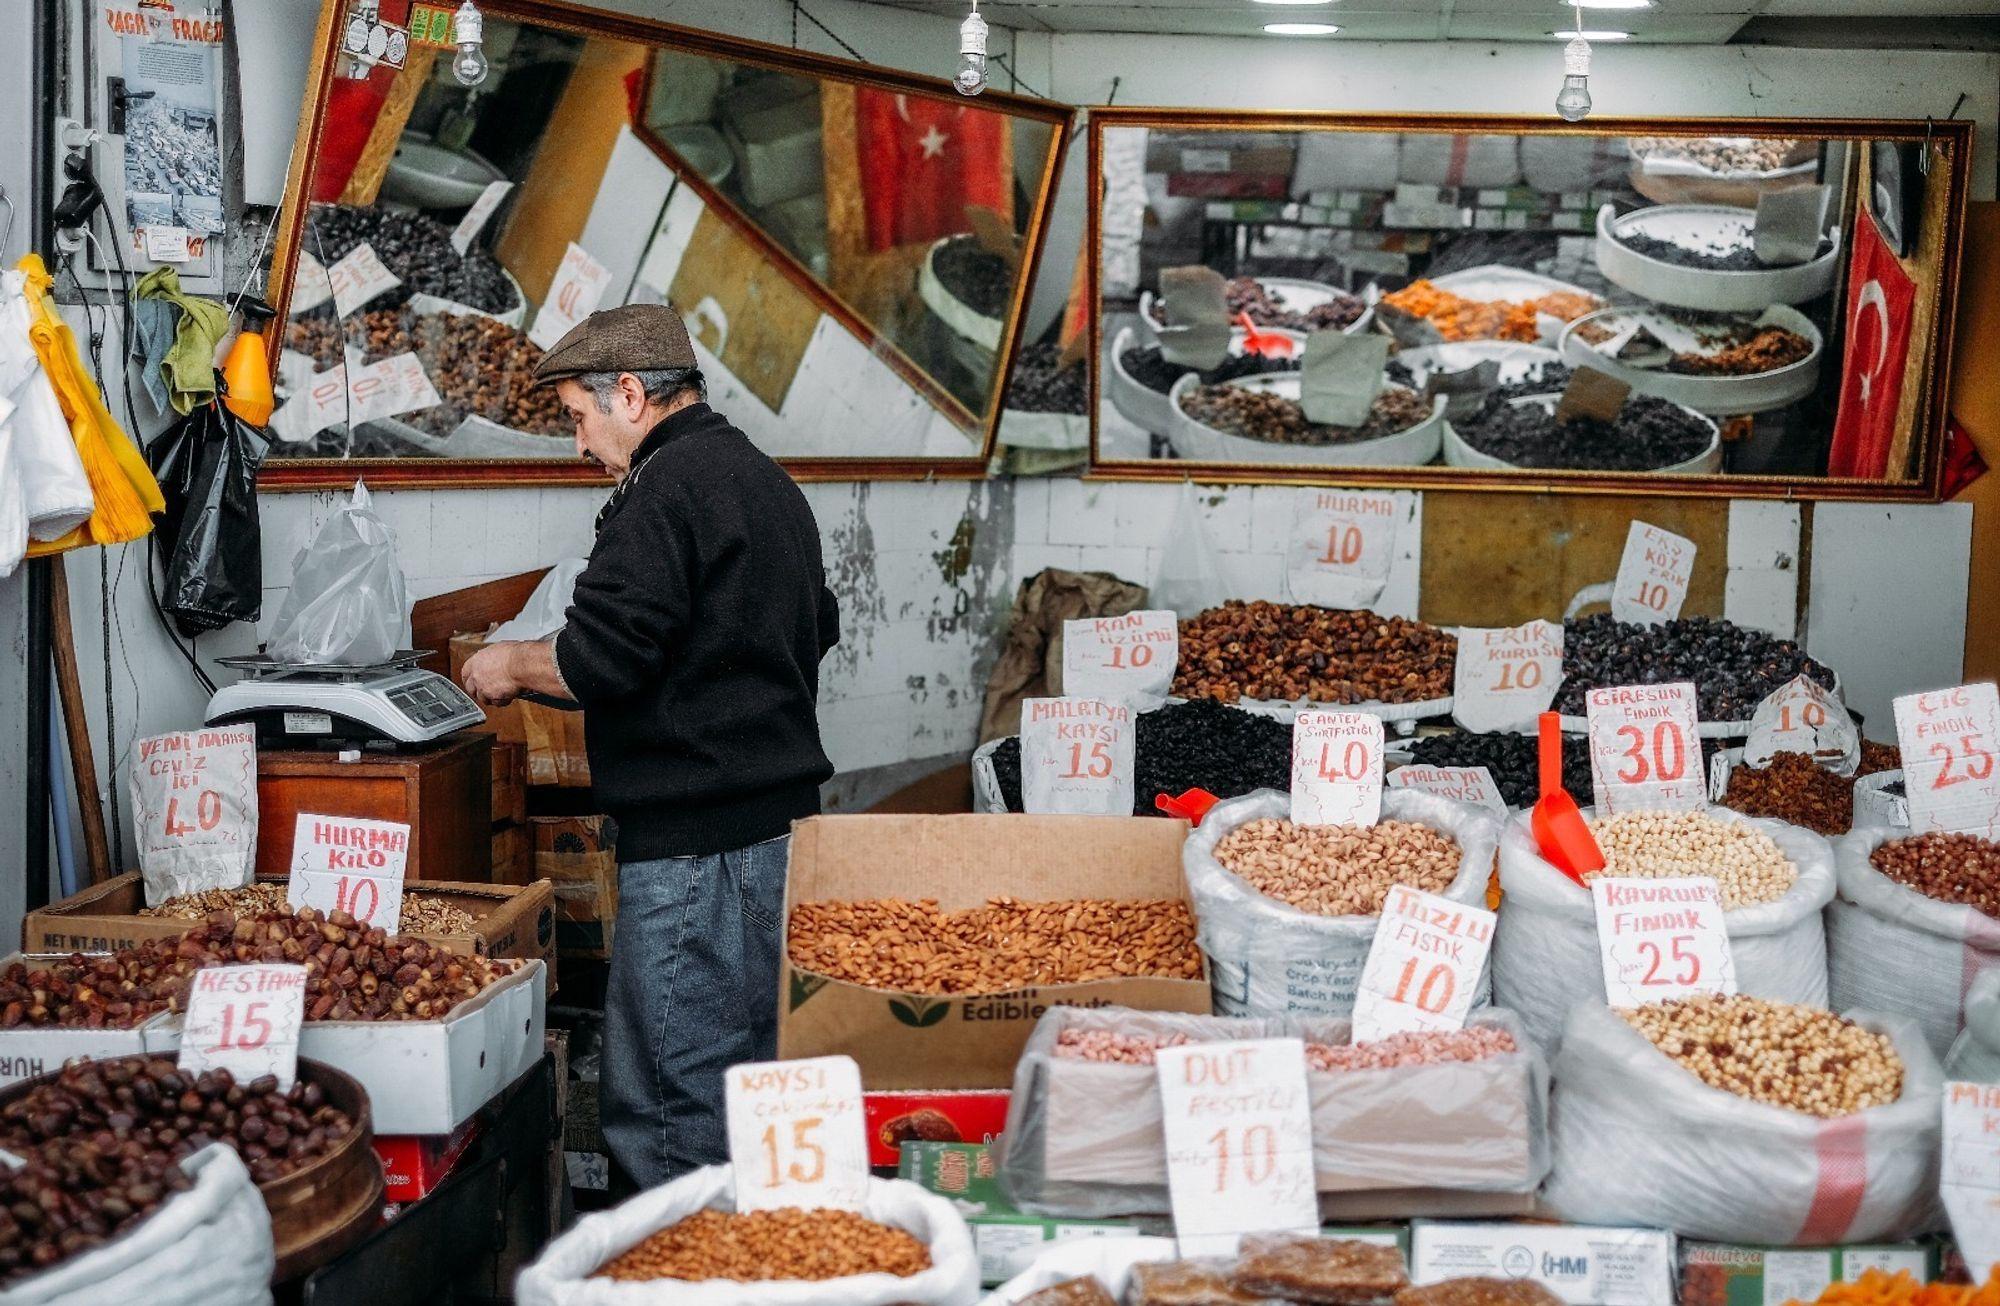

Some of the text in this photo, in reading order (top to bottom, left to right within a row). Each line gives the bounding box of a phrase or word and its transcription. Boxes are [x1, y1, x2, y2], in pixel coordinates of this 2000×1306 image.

[1316, 494, 1393, 517] HURMA
[1317, 526, 1363, 564] 10
[1631, 580, 1668, 611] 10
[1101, 644, 1153, 669] 10
[1490, 660, 1543, 692] 10
[1032, 699, 1128, 722] MALATYA
[1773, 703, 1825, 732] 10
[1057, 742, 1123, 779] 15
[1317, 741, 1369, 783] 40
[1617, 721, 1685, 784] 30
[1660, 788, 1685, 799] TL
[1929, 733, 1994, 791] 25
[165, 790, 222, 837] 40
[314, 822, 406, 853] HURMA
[336, 876, 379, 921] 10
[1394, 887, 1491, 944] TUZLU
[44, 933, 67, 948] NET
[1286, 968, 1357, 985] Crop Year
[1637, 935, 1701, 986] 25
[1287, 985, 1328, 1001] Batch
[1387, 956, 1457, 1014] 10
[203, 1002, 273, 1055] 15
[963, 1001, 1047, 1021] Edible
[1183, 1046, 1258, 1086] DUT
[761, 1117, 826, 1189] 15
[1207, 1124, 1276, 1194] 10
